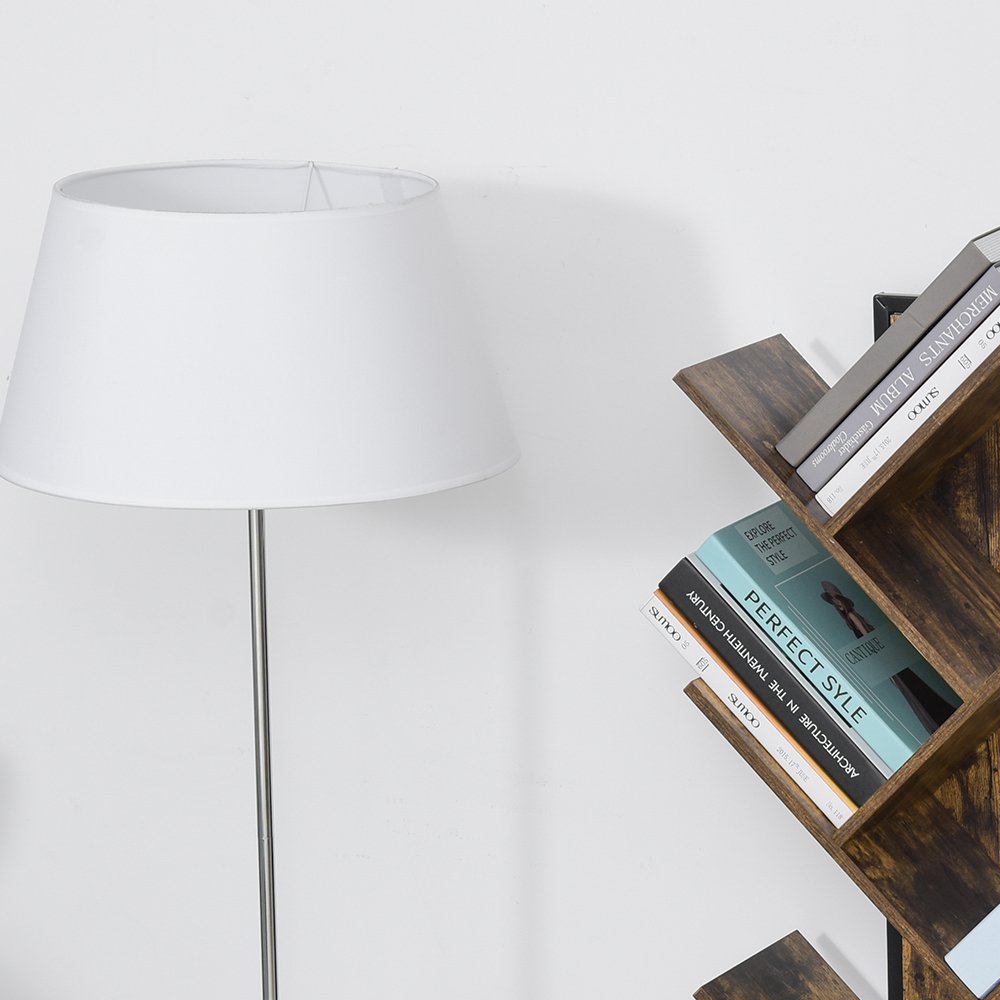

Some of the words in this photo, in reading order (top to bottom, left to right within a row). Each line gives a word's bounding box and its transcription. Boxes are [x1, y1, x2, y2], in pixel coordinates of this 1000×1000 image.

[918, 285, 998, 366] MERCHANTS
[870, 367, 915, 416] ALBUM
[811, 430, 848, 468] Cloakrooms
[744, 520, 776, 541] EXPLORE
[754, 538, 772, 553] THE
[769, 527, 797, 549] PERFECT
[765, 550, 788, 566] STYLE
[686, 590, 726, 632] CENTURY
[723, 629, 769, 681] TWENTIETH
[744, 590, 824, 673] PERFECT
[822, 675, 867, 724] SYLE
[844, 637, 885, 665] CANTIQUE
[768, 679, 787, 701] THE
[786, 699, 799, 714] IN
[799, 713, 860, 778] ARCHITECTURE
